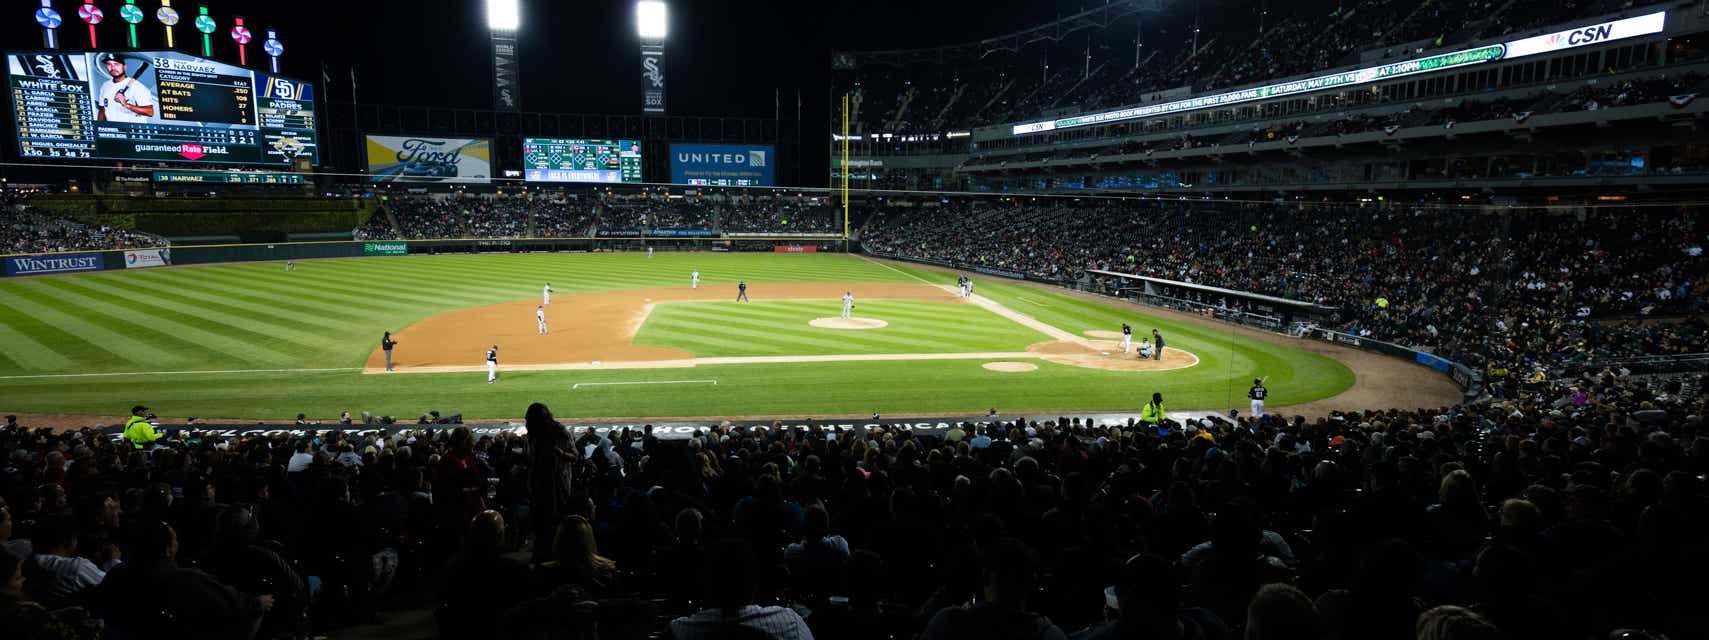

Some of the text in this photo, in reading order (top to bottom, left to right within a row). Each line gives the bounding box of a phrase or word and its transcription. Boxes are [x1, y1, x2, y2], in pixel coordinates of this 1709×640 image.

[1568, 24, 1613, 46] CSN
[154, 58, 170, 68] 38
[174, 64, 216, 73] NARVAEZ
[1308, 80, 1322, 88] MAY
[1325, 76, 1344, 86] 27TH
[1346, 74, 1354, 82] VS
[1380, 67, 1390, 76] AT
[1392, 62, 1420, 74] 1:10PM
[18, 80, 83, 92] WHITE SOX
[160, 81, 196, 90] AVERAGE
[163, 104, 193, 112] HOMERS
[270, 102, 302, 110] PADRES
[135, 144, 182, 153] guaranteed
[182, 145, 202, 153] Rate
[396, 138, 462, 164] Ford
[679, 153, 745, 163] UNITED
[374, 242, 406, 250] National
[14, 256, 97, 272] WINTRUST
